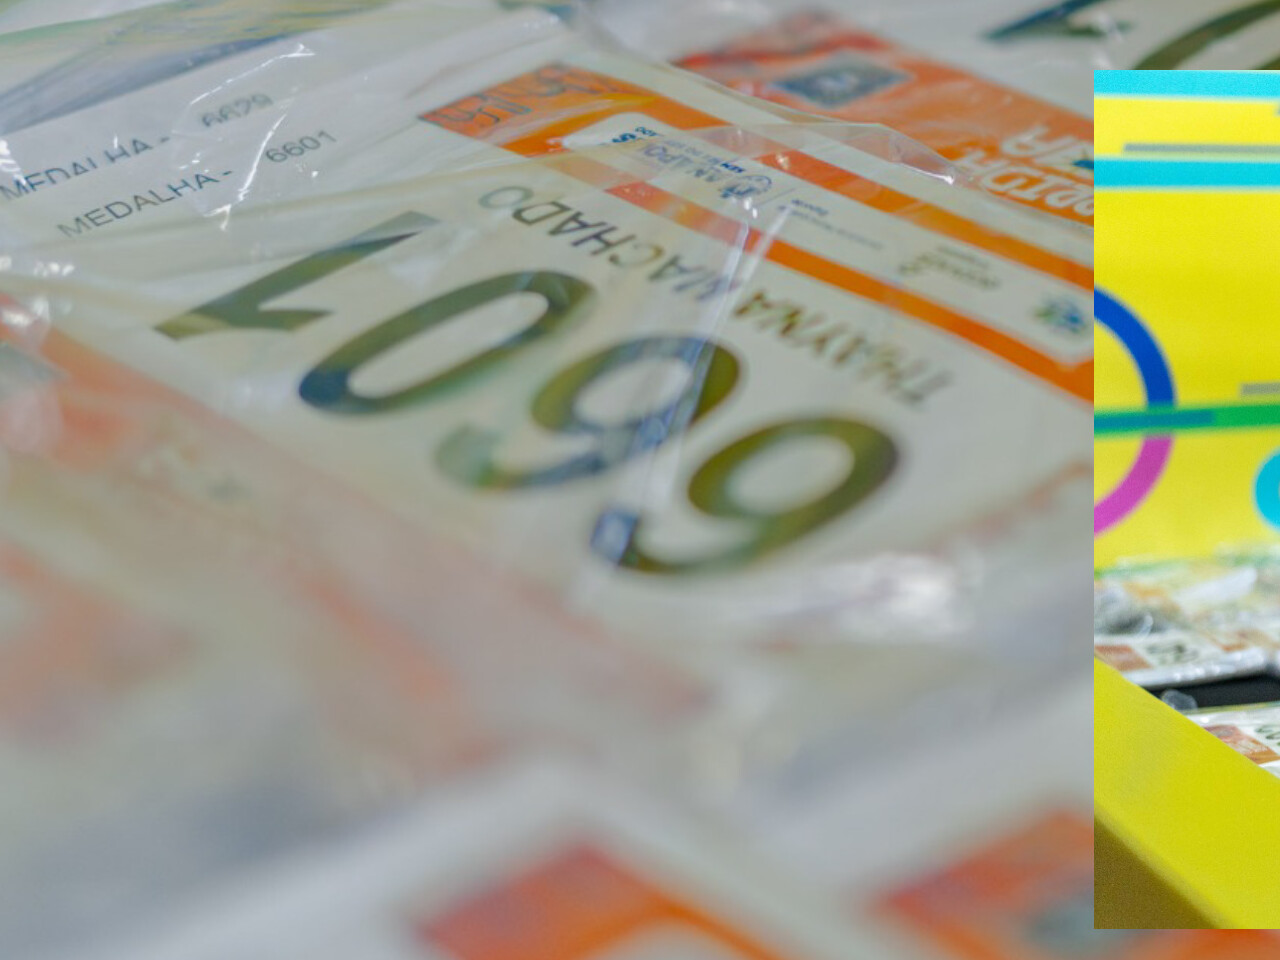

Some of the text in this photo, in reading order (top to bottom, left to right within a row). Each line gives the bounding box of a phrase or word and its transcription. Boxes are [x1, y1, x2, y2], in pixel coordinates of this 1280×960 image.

[264, 129, 338, 164] 6601
[476, 183, 735, 306] MACHADO
[152, 210, 903, 576] 6601
[730, 283, 954, 410] THAYNA
